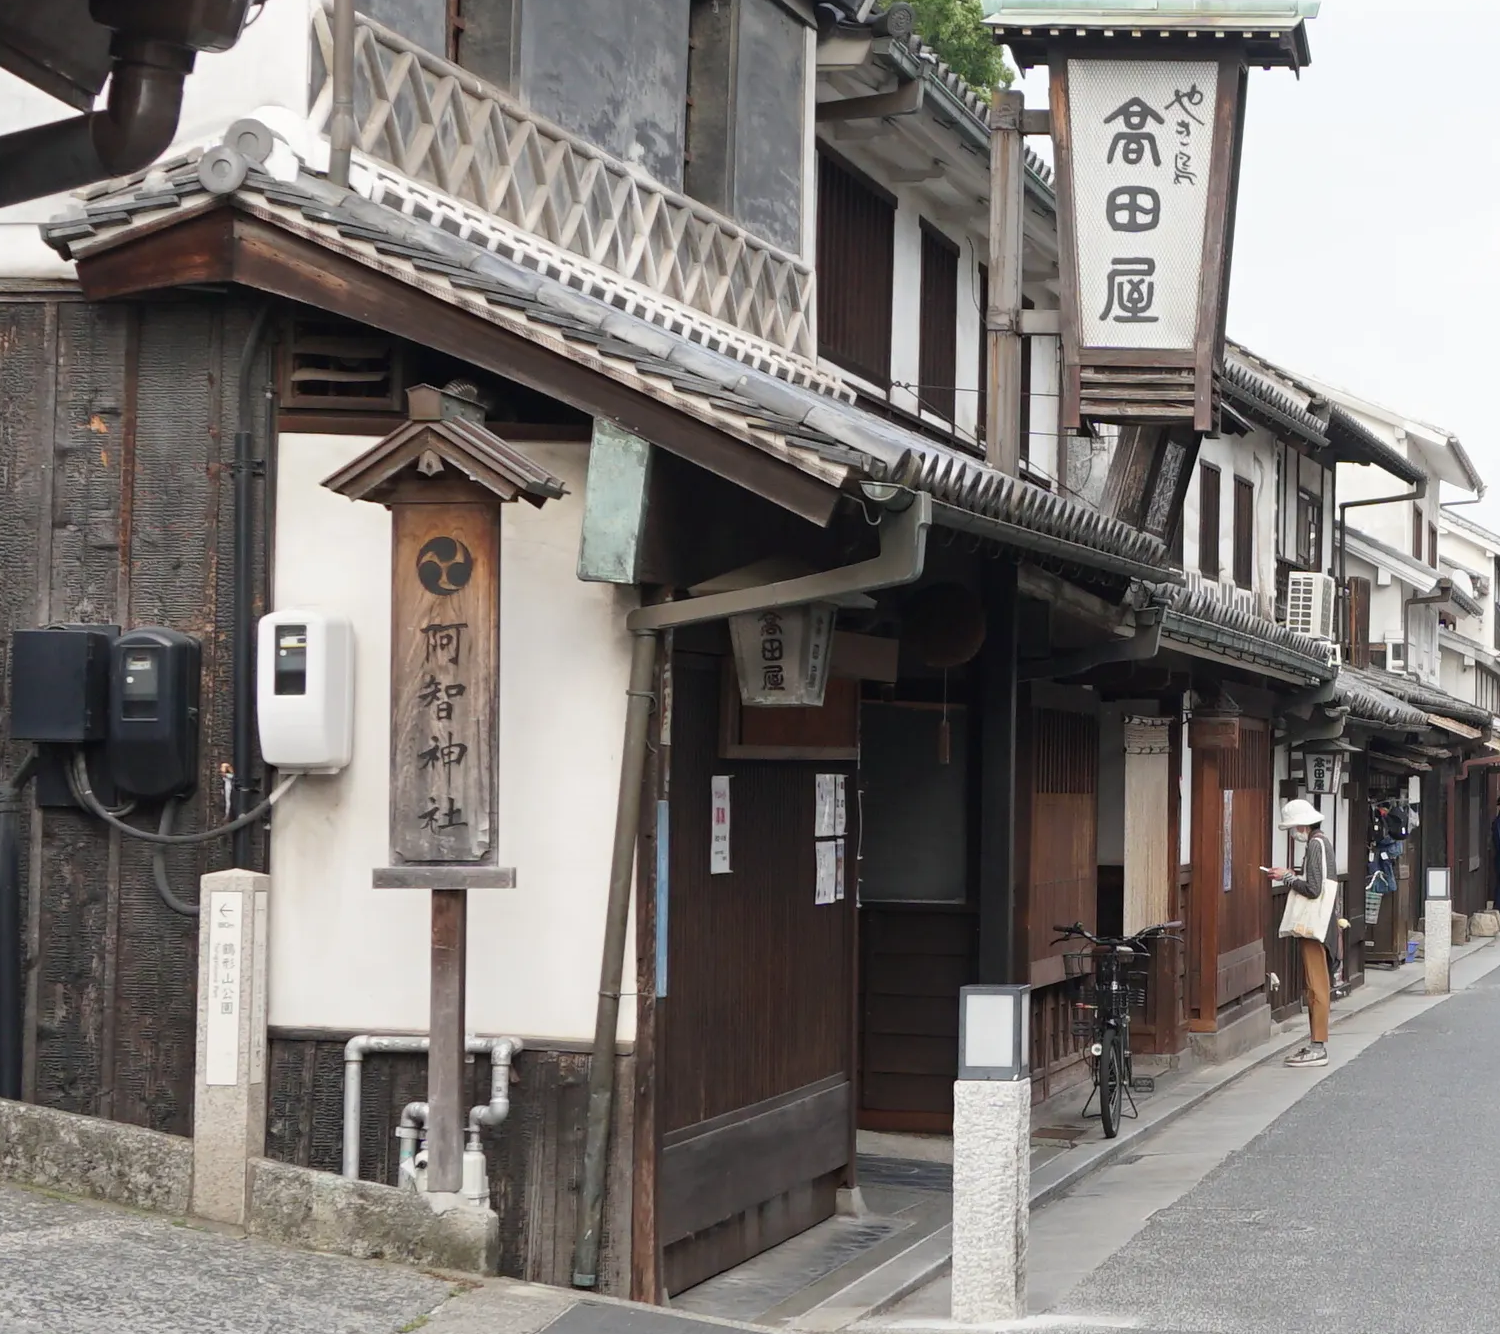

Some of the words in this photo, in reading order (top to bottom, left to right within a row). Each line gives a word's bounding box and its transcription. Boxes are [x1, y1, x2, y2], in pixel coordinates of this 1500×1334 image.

[1100, 96, 1165, 323] 高田屋
[417, 621, 469, 833] 阿智神社
[757, 611, 786, 691] 高田屋
